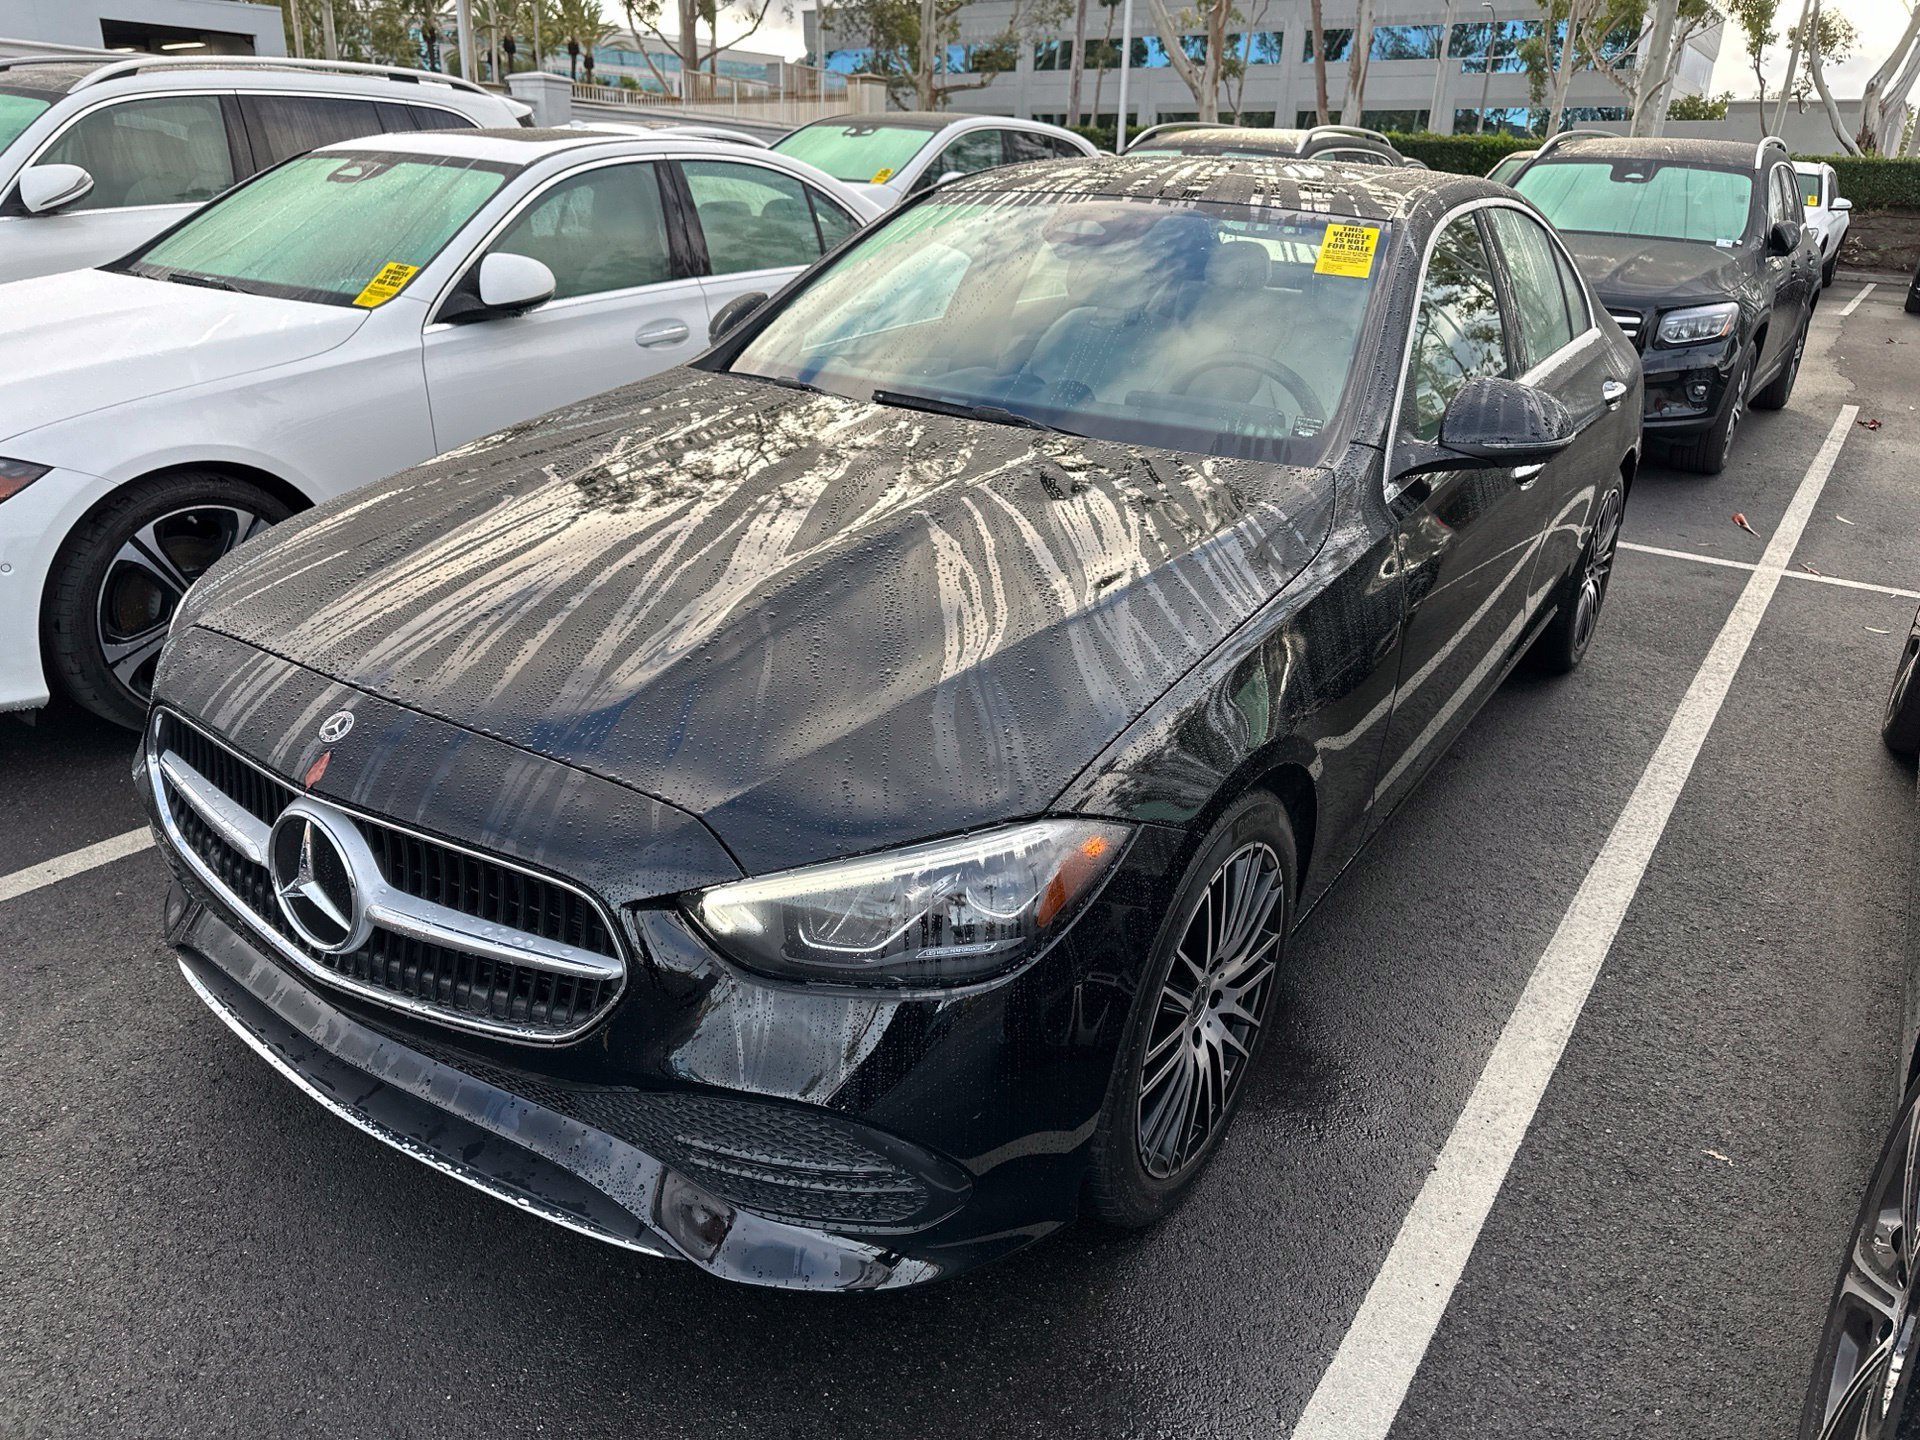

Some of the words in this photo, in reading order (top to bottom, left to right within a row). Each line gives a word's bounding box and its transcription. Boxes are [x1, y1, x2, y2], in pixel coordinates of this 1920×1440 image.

[1332, 231, 1372, 240] VEHICLE
[1327, 242, 1345, 250] FOR
[1347, 244, 1371, 252] SALE
